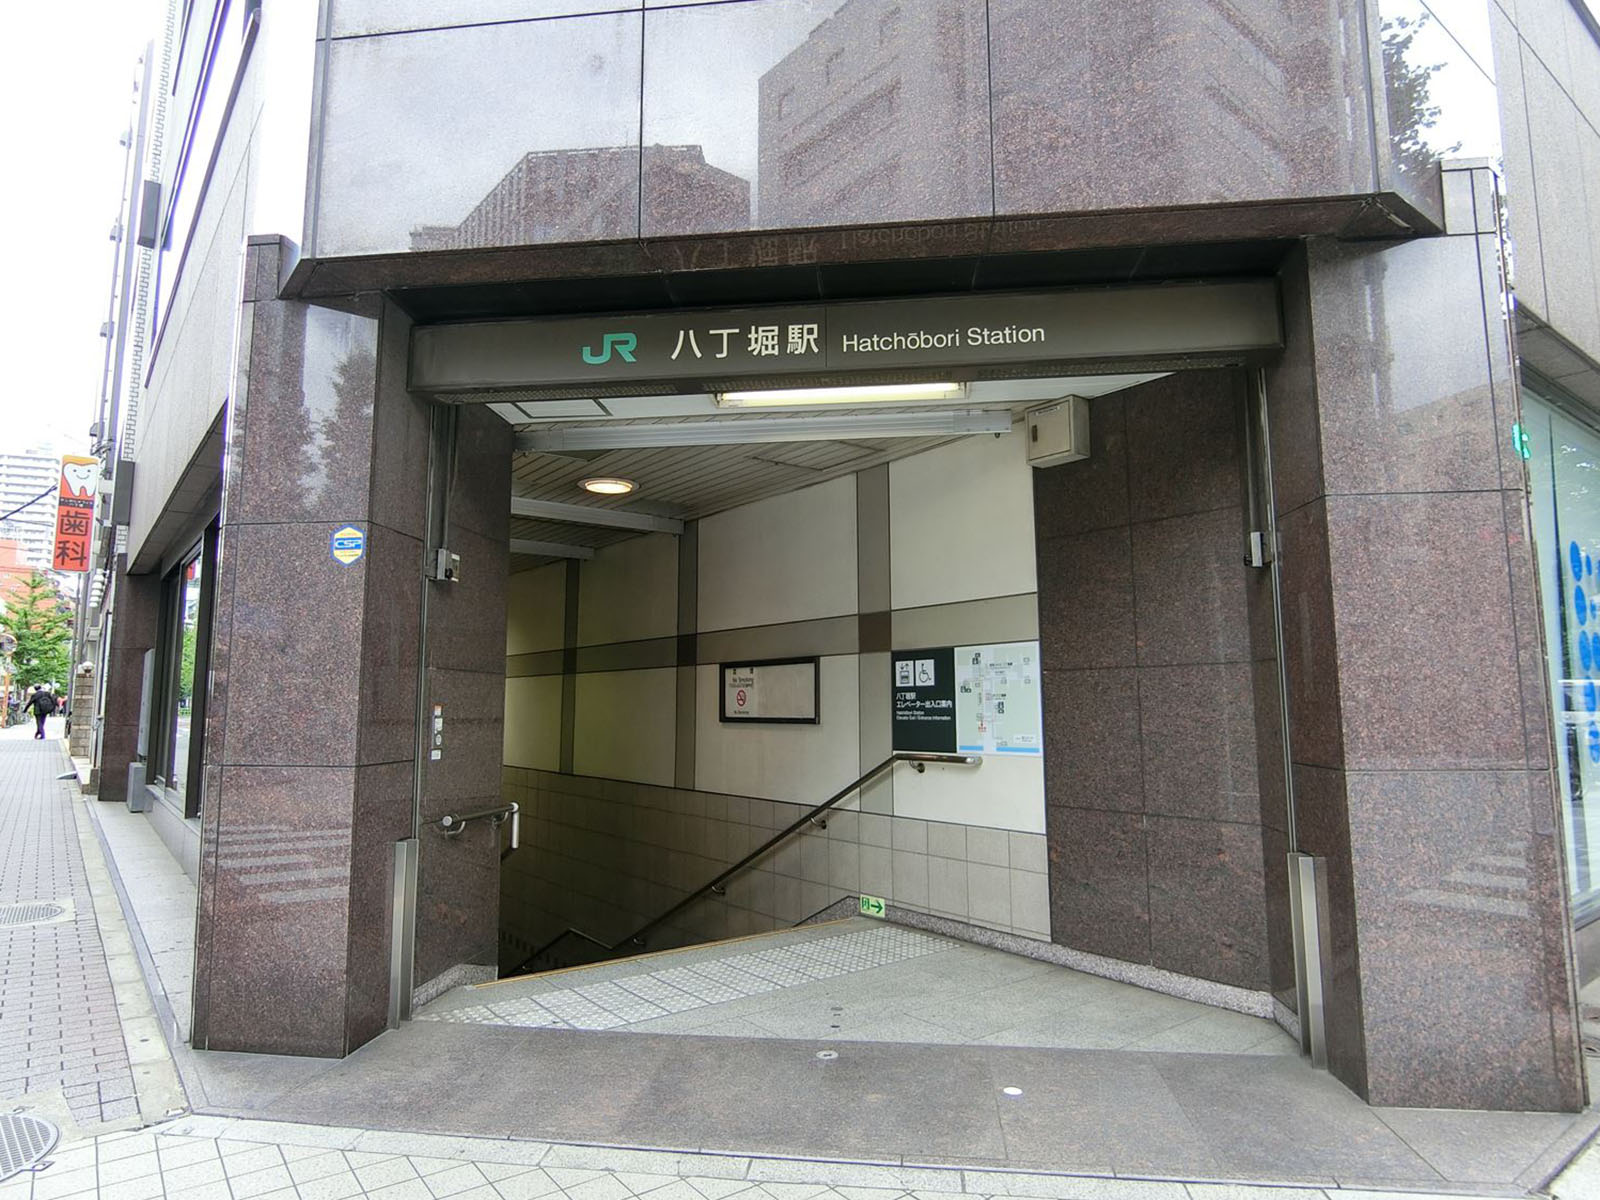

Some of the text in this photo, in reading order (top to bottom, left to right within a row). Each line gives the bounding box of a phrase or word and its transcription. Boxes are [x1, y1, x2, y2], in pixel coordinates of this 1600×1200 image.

[581, 332, 637, 365] JR
[671, 323, 819, 361] 八丁堀駅
[842, 325, 1045, 354] Hatchōbori Station
[56, 510, 91, 567] 歯科
[335, 539, 362, 549] CSP
